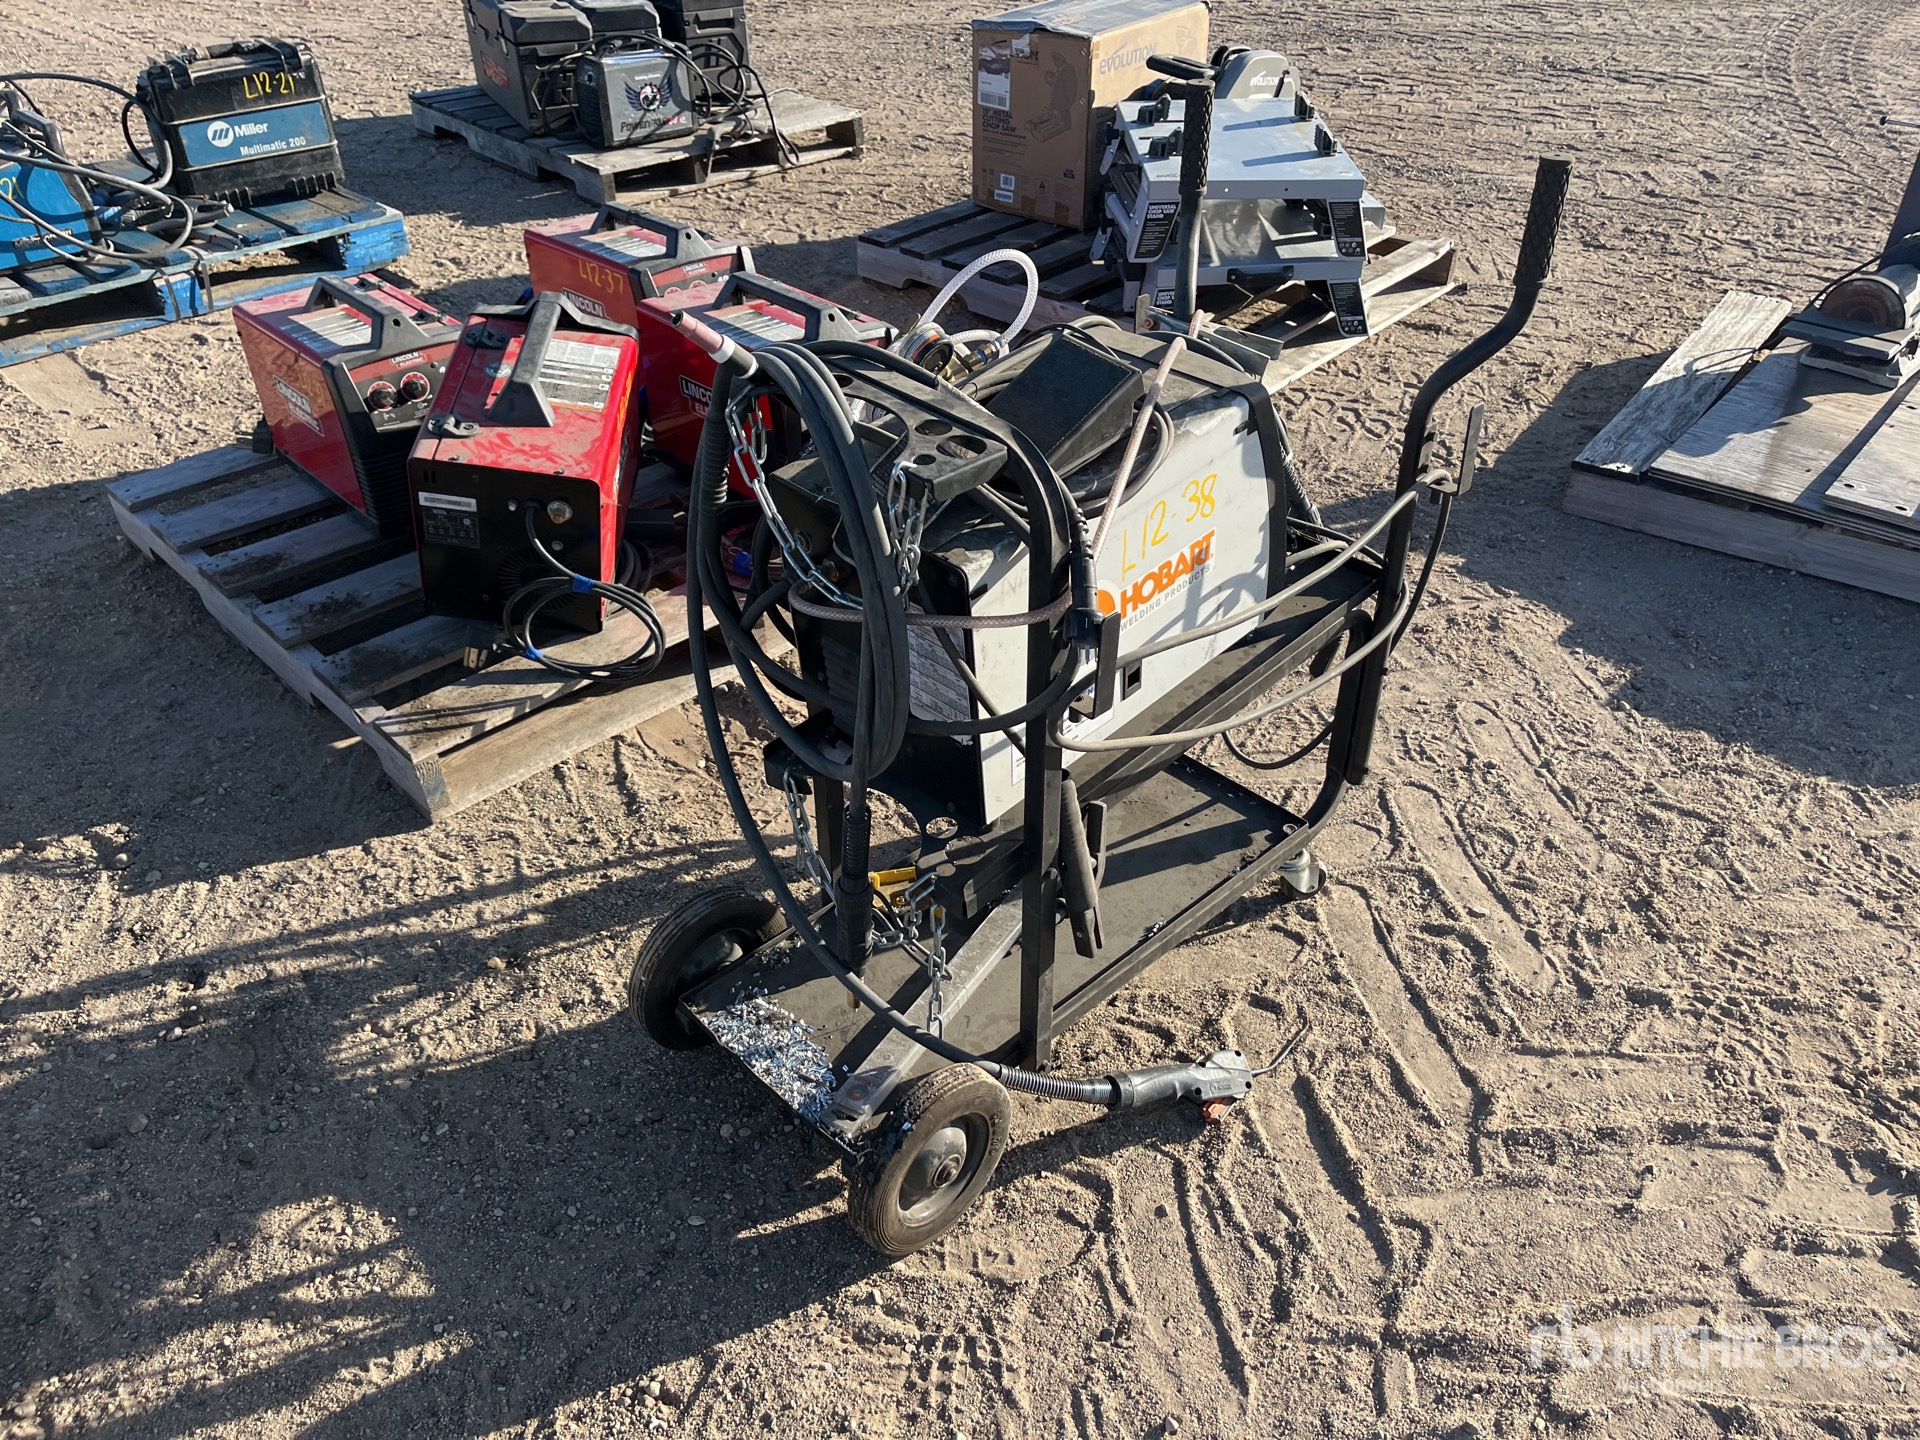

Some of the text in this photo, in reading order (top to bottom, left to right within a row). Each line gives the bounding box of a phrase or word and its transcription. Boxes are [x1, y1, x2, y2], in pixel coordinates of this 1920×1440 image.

[243, 72, 295, 98] L12-21
[983, 115, 1010, 125] CUTTING
[992, 109, 1013, 119] METAL
[234, 123, 269, 137] Miller
[983, 121, 1017, 133] CHOP SAW
[240, 136, 307, 156] Multimatic 200
[579, 259, 623, 293] L12-37
[392, 351, 420, 364] LINCOLN
[681, 379, 713, 404] LINCO
[1121, 473, 1218, 582] L12-38
[1120, 529, 1216, 619] HOBART
[1120, 564, 1211, 632] WELDING PRODUCTS
